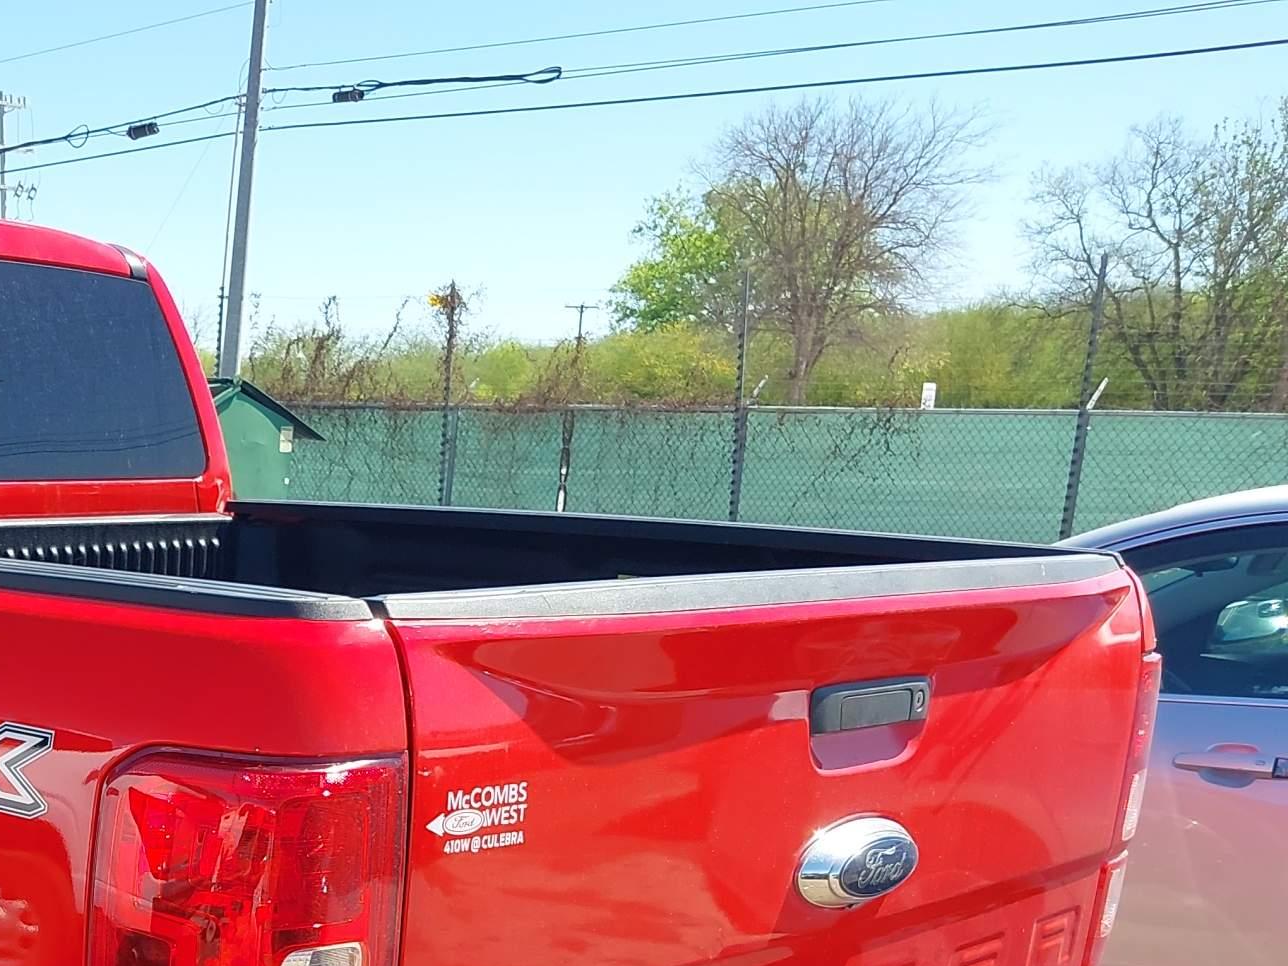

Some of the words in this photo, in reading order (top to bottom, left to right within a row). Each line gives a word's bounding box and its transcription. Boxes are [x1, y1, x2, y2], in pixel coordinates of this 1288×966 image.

[447, 781, 528, 811] McCOMBS
[452, 815, 475, 829] Ford
[483, 804, 528, 827] WEST
[857, 841, 907, 888] Ford
